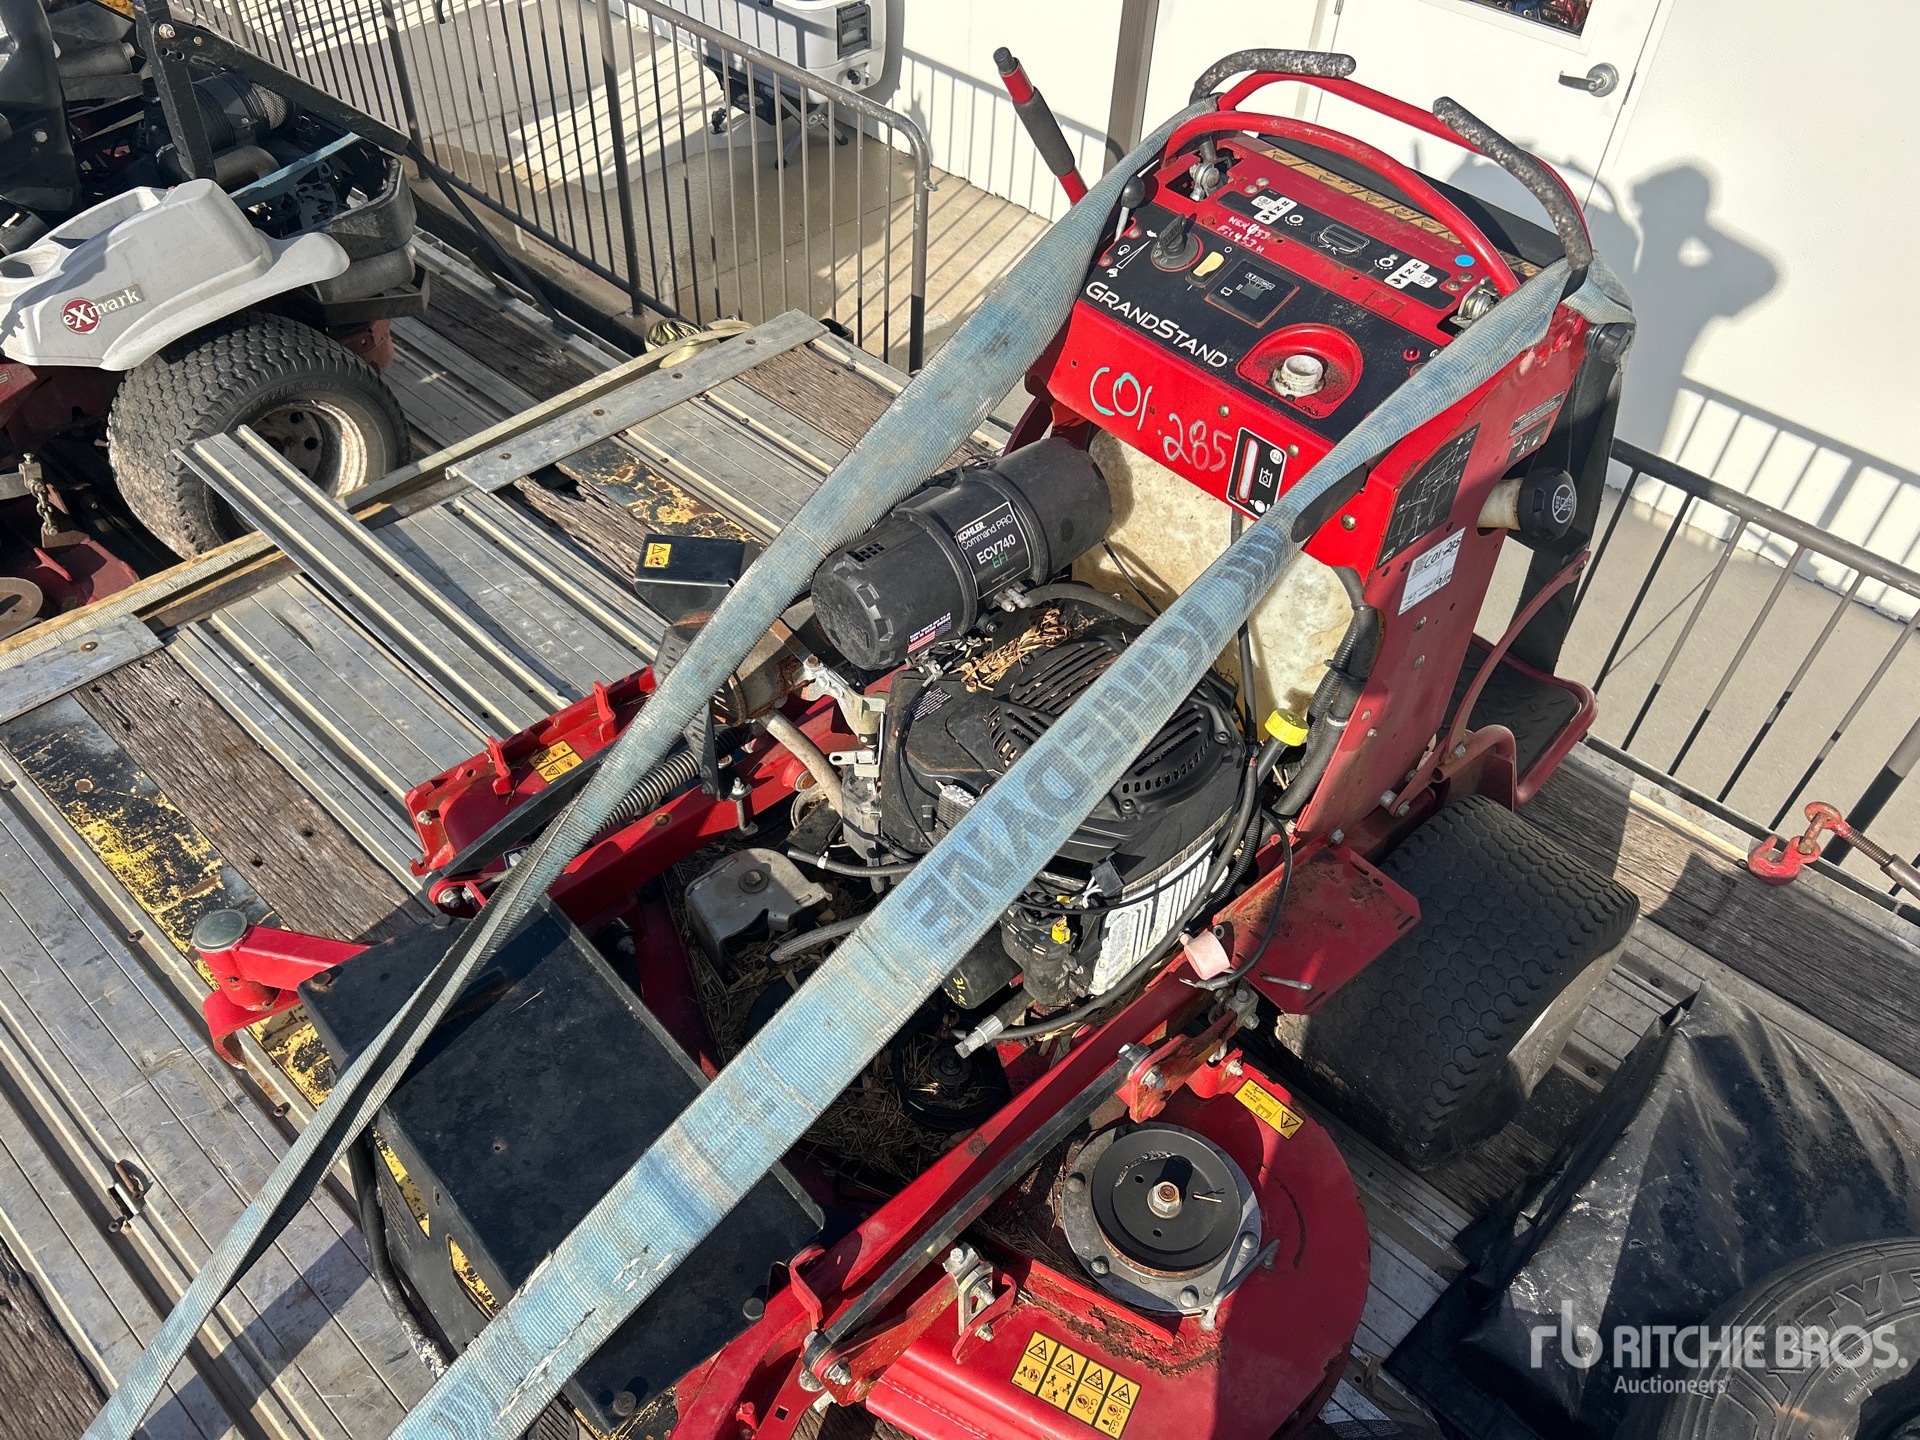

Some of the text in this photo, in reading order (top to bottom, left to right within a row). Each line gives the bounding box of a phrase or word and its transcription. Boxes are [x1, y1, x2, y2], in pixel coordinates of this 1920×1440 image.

[961, 514, 1013, 550] Command PRO
[976, 534, 1016, 565] ECV740
[991, 551, 1009, 569] EFI
